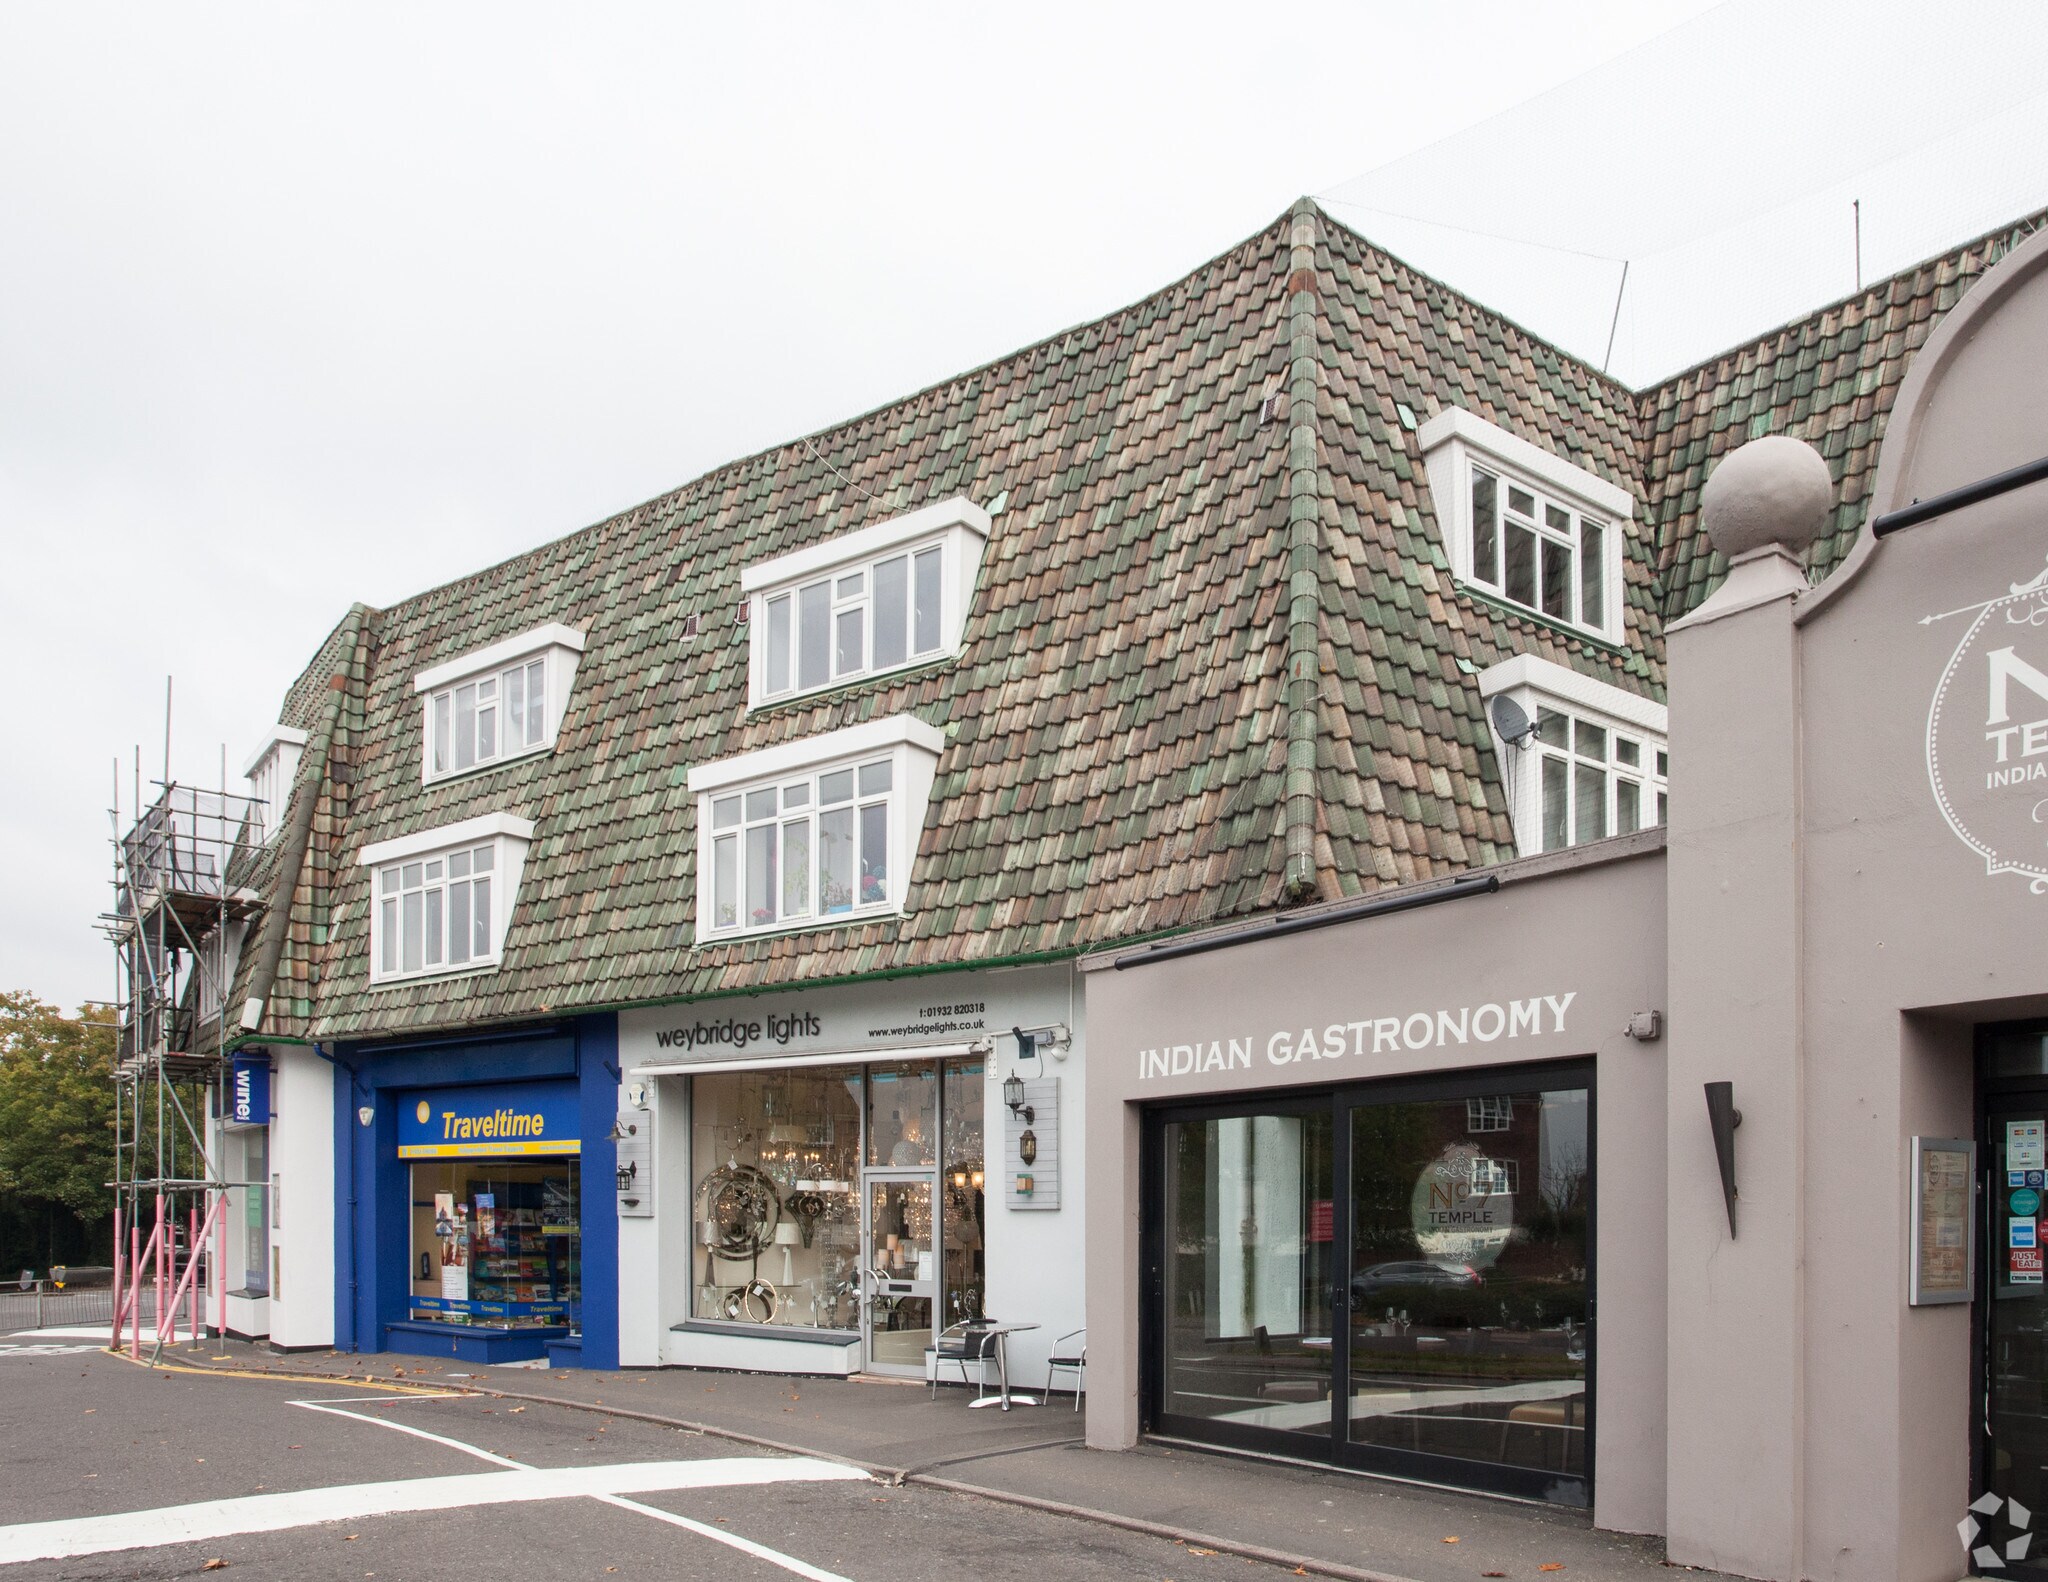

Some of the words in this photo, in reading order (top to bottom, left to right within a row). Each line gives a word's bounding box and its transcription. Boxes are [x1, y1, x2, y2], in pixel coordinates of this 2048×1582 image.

[1986, 761, 2047, 790] INDIA
[919, 1005, 952, 1018] t:01932
[954, 1002, 985, 1015] 820318
[656, 1018, 760, 1051] weybridge
[767, 1012, 820, 1045] lights
[868, 1018, 985, 1038] www.weybridgelights.co.uk
[1138, 1036, 1254, 1080] INDIAN
[1267, 992, 1577, 1066] GASTRONOMY
[236, 1069, 251, 1116] wine
[442, 1108, 545, 1139] Traveltime
[1428, 1211, 1493, 1224] TEMPLE
[2012, 1252, 2035, 1260] JUST
[530, 1305, 564, 1313] Traveltime
